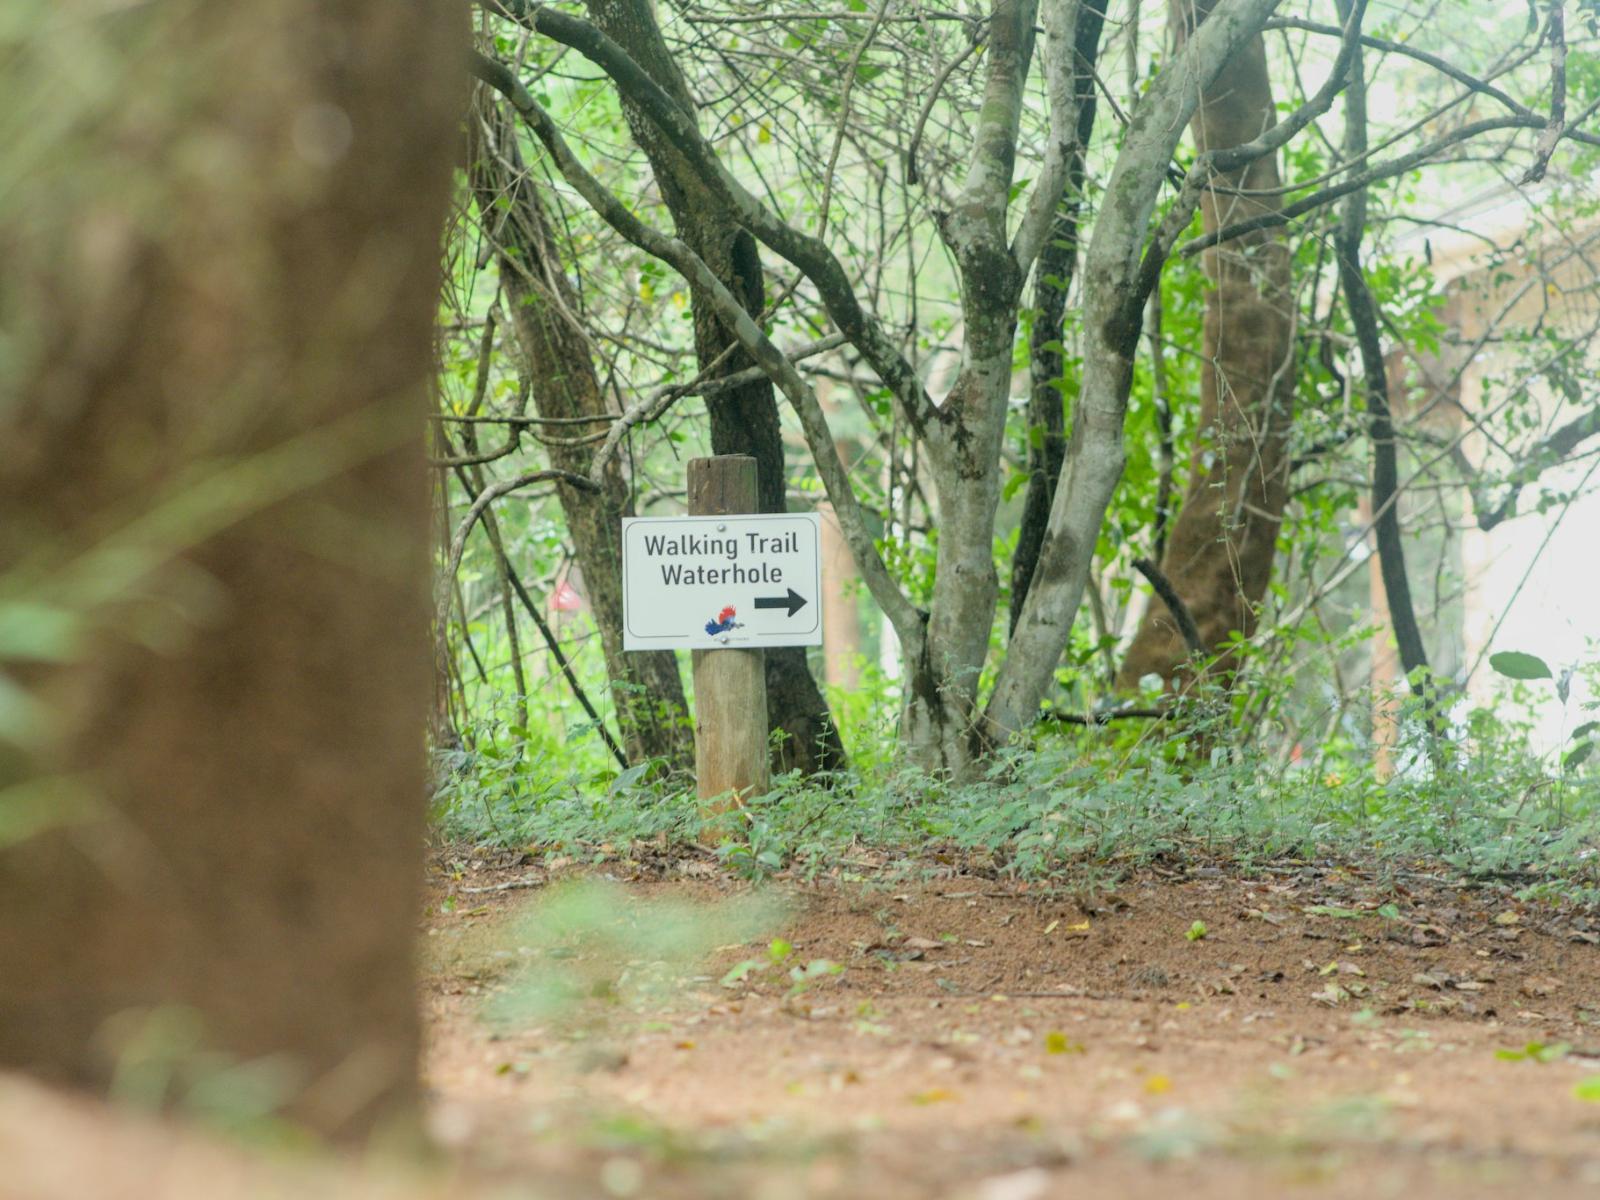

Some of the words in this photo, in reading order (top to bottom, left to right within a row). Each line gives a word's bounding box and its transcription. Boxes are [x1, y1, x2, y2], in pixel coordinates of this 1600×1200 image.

[644, 533, 738, 560] Walking
[746, 531, 799, 554] Trail
[661, 562, 783, 585] Waterhole
